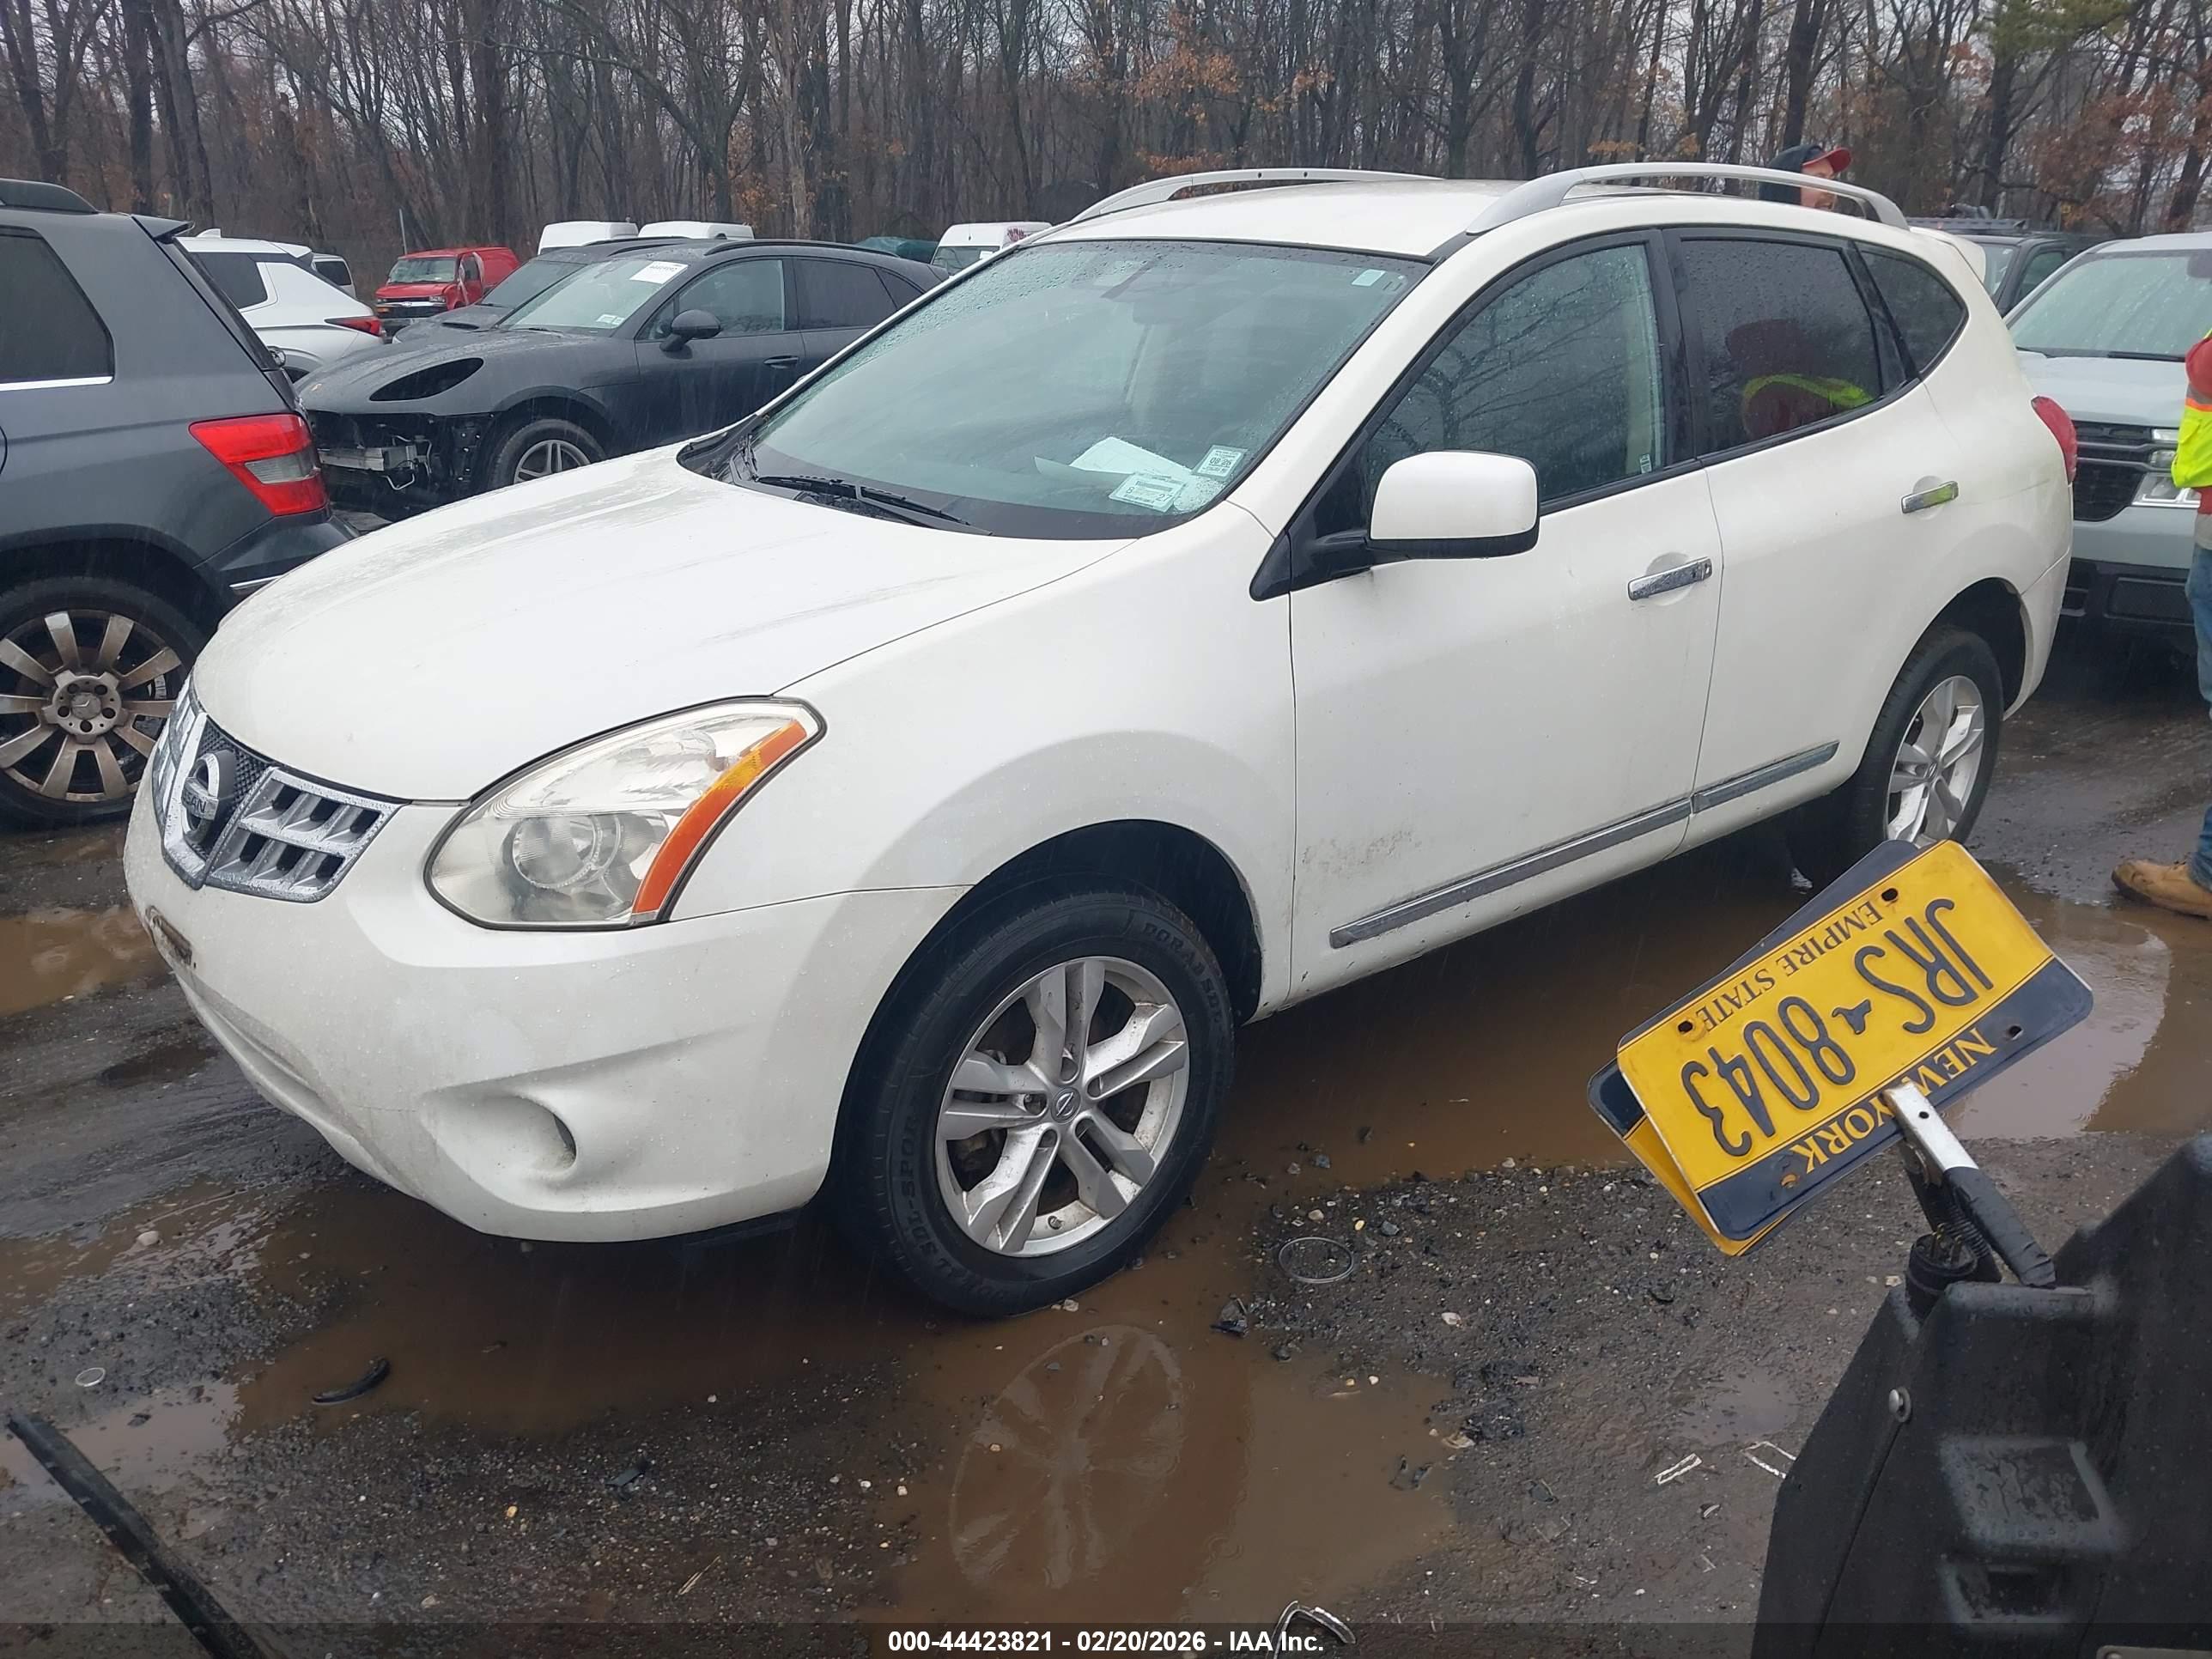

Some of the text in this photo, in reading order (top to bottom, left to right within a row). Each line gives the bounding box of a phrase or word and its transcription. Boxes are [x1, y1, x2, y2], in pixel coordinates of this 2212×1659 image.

[1680, 898, 1994, 1157] JRS 8043
[1696, 902, 1883, 1032] EMPIRE STATE
[1790, 1096, 1895, 1174] YORK
